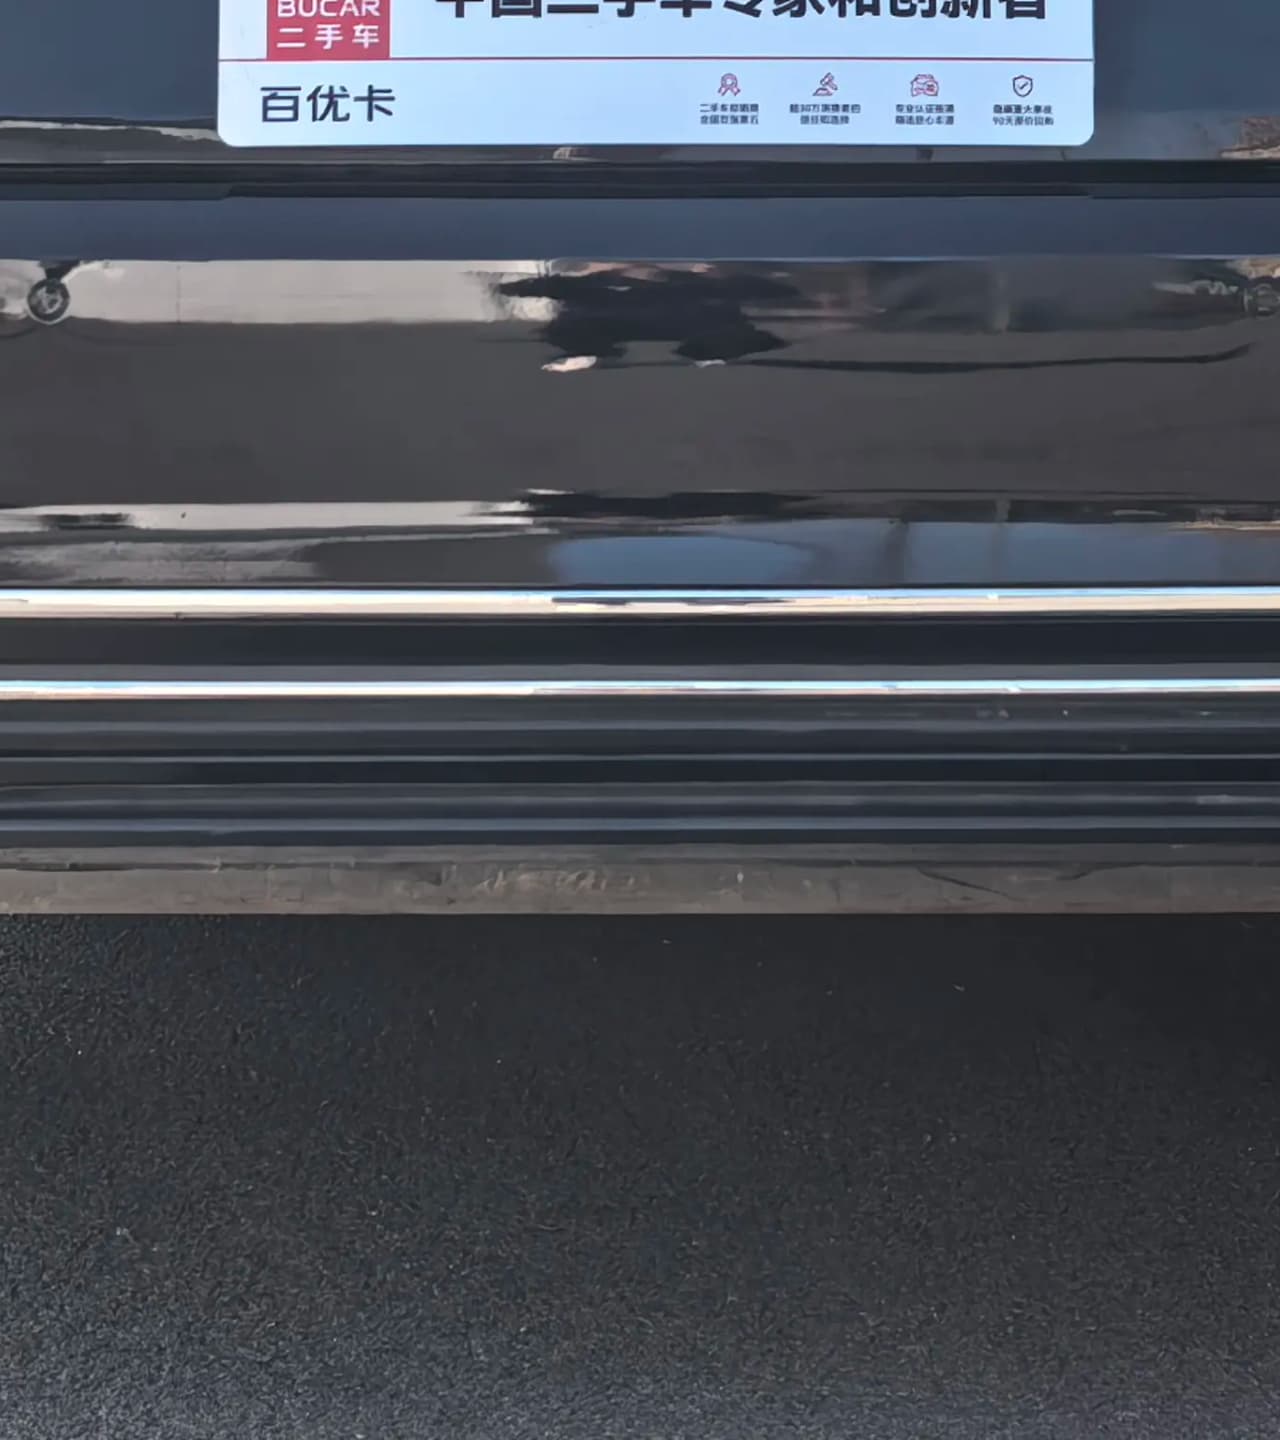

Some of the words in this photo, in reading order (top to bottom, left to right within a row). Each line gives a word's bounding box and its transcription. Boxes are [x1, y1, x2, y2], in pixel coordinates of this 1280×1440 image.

[276, 23, 380, 50] 二手车
[259, 83, 397, 123] 百优卡
